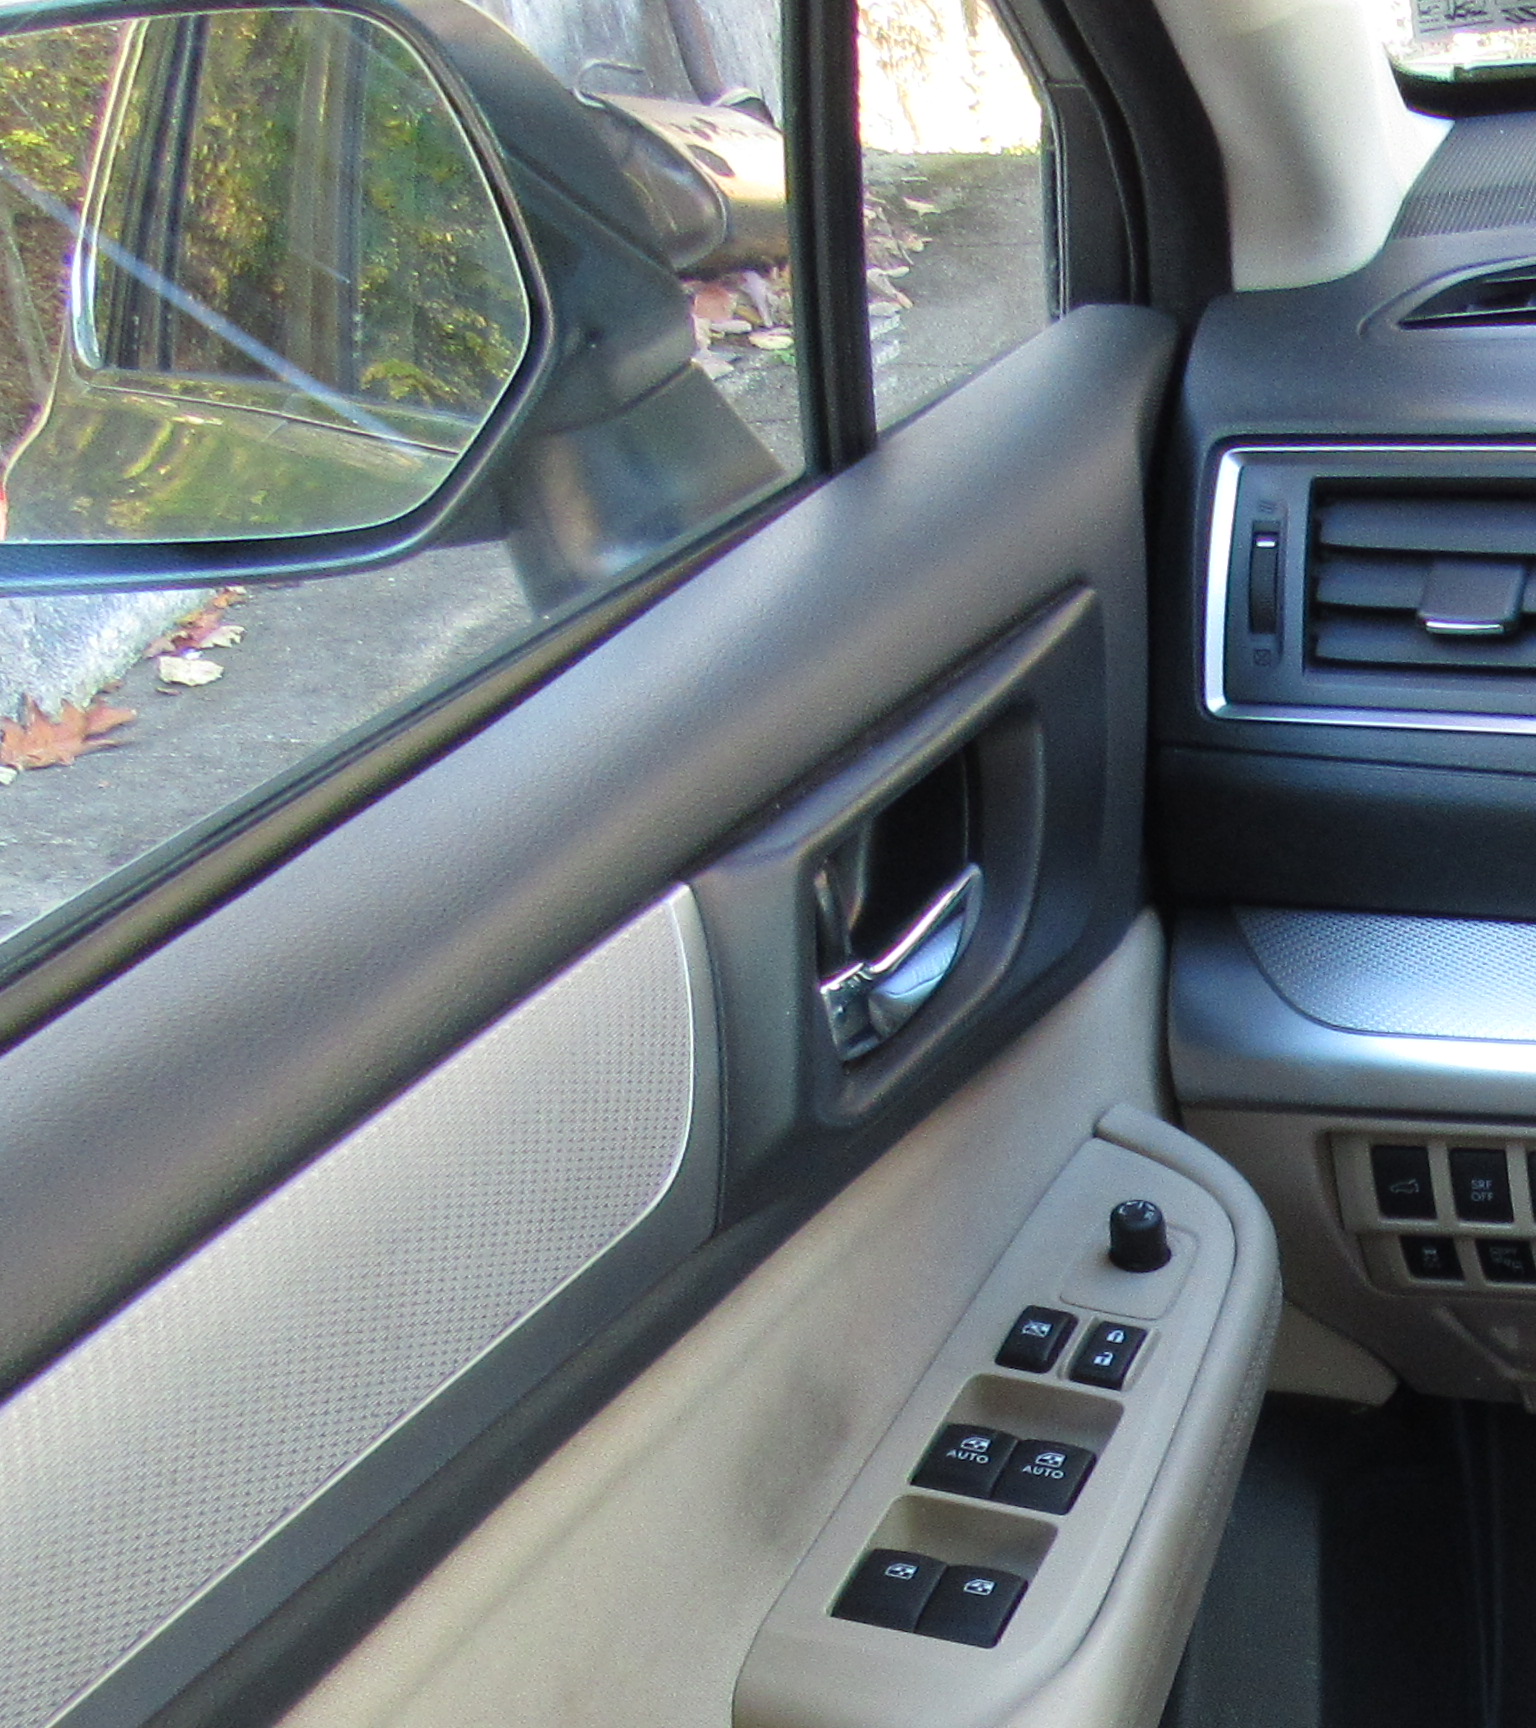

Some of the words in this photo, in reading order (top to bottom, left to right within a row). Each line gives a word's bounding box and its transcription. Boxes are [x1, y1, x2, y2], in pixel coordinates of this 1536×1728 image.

[1471, 1191, 1494, 1201] OFF
[945, 1448, 990, 1465] AUTO
[1021, 1464, 1065, 1480] AUTO
